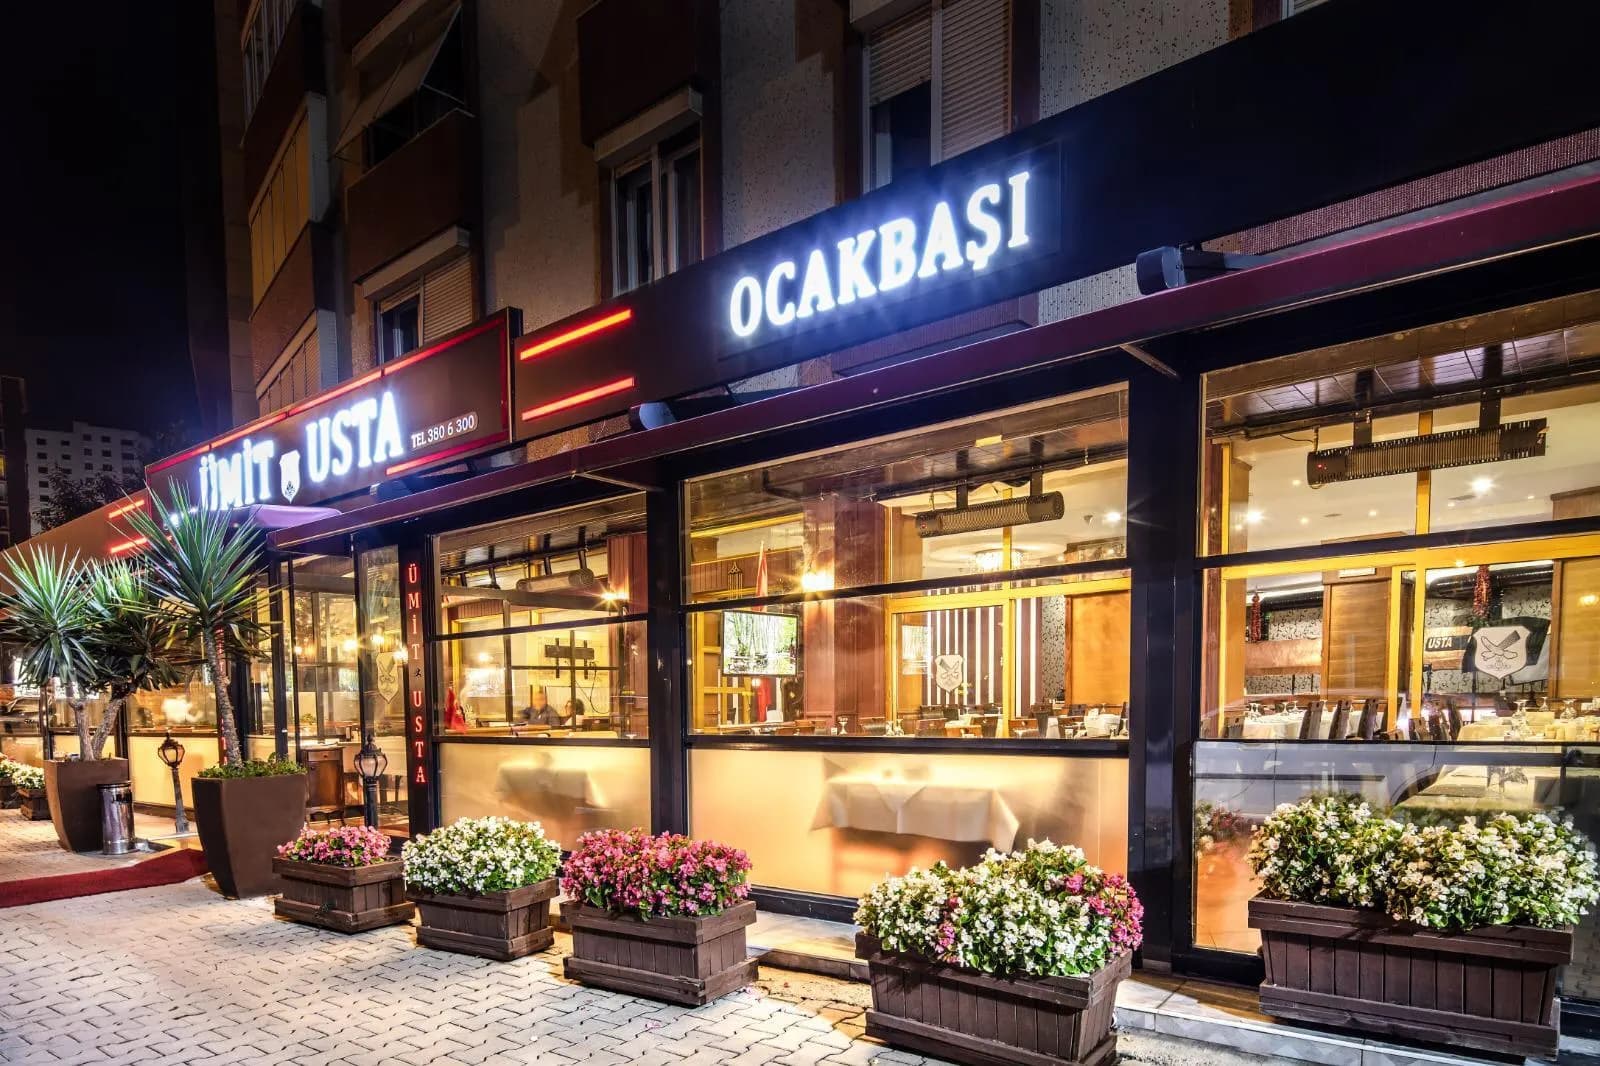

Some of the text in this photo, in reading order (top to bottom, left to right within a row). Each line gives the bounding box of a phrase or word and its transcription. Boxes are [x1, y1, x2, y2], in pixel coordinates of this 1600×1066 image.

[730, 171, 1031, 337] OCAKBAŞI
[305, 391, 403, 482] USTA
[411, 414, 474, 448] TEL 380 6 300
[408, 563, 425, 783] ÜMİT USTA
[1428, 637, 1452, 649] USTA
